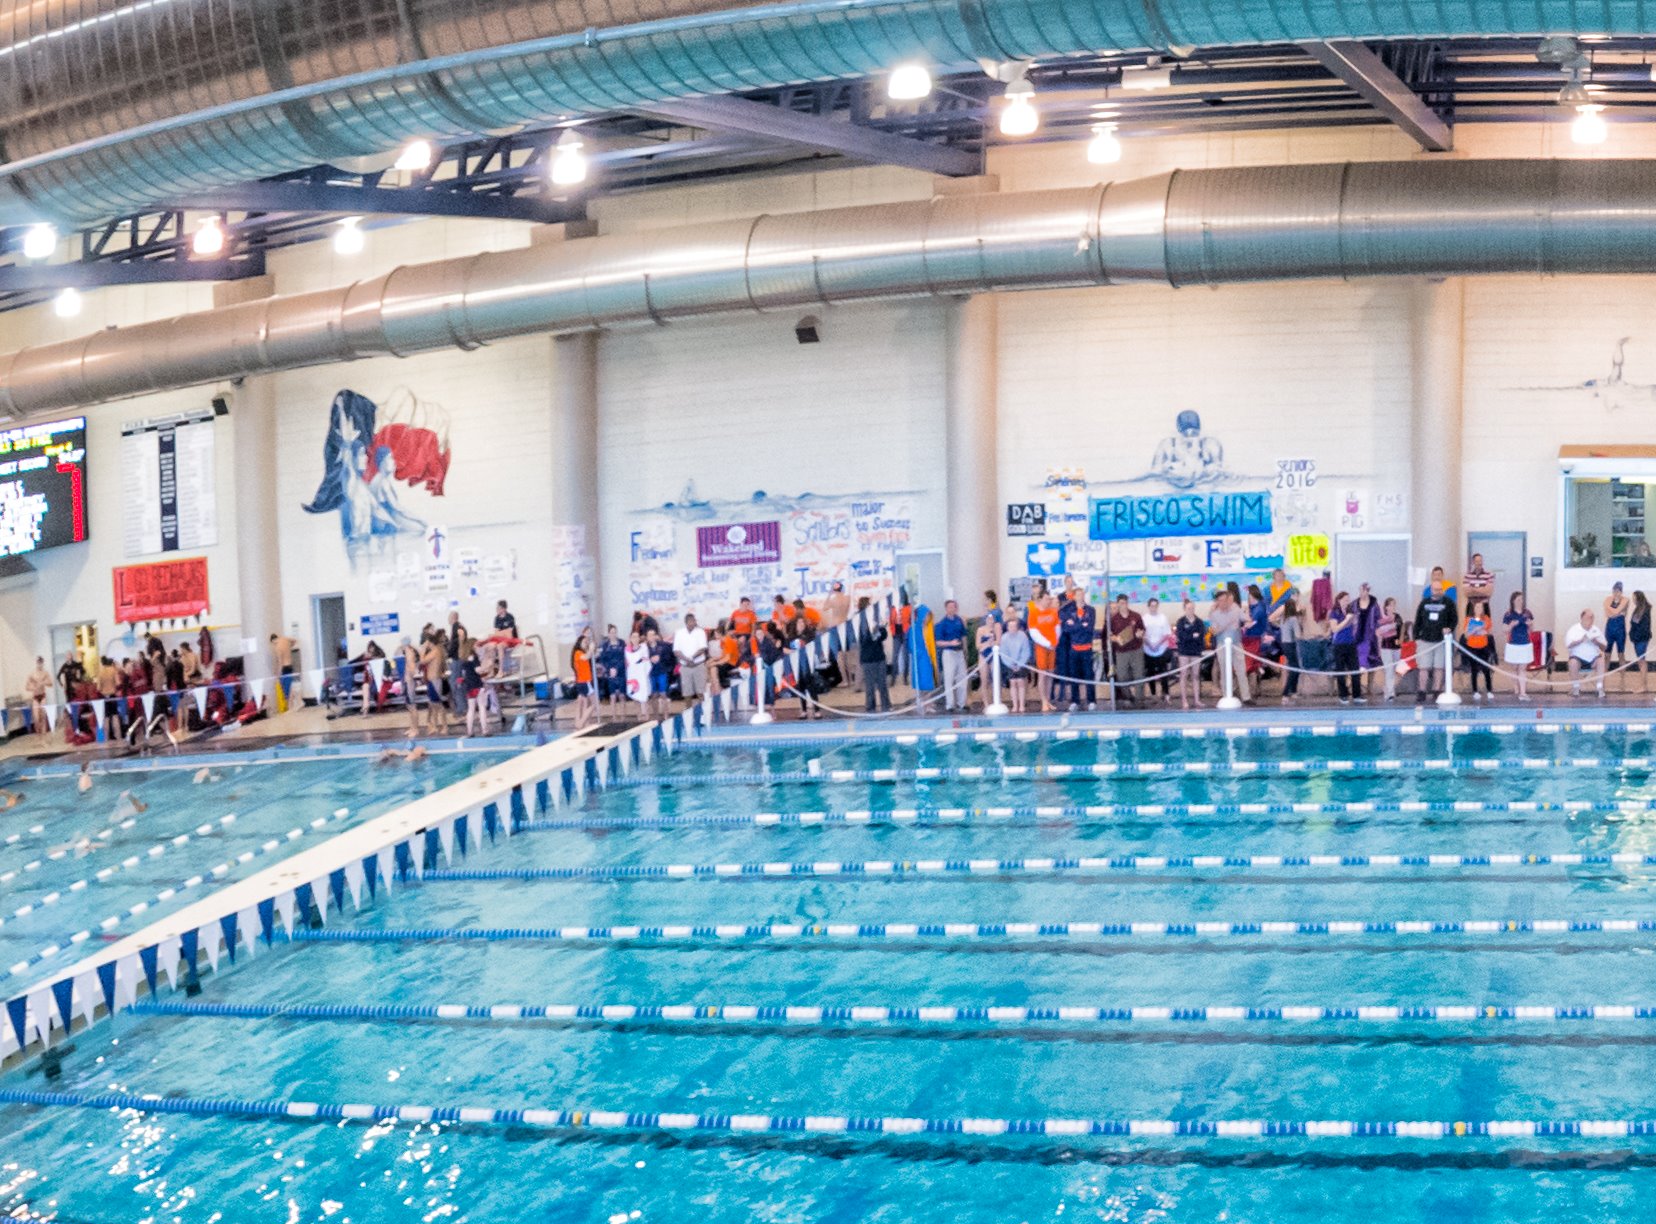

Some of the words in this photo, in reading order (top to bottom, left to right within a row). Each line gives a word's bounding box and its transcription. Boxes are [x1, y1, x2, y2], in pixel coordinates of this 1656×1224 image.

[1276, 472, 1316, 488] 2016
[1012, 505, 1043, 520] DAB
[1096, 499, 1180, 531] FRISCO
[1187, 495, 1264, 527] SWIM
